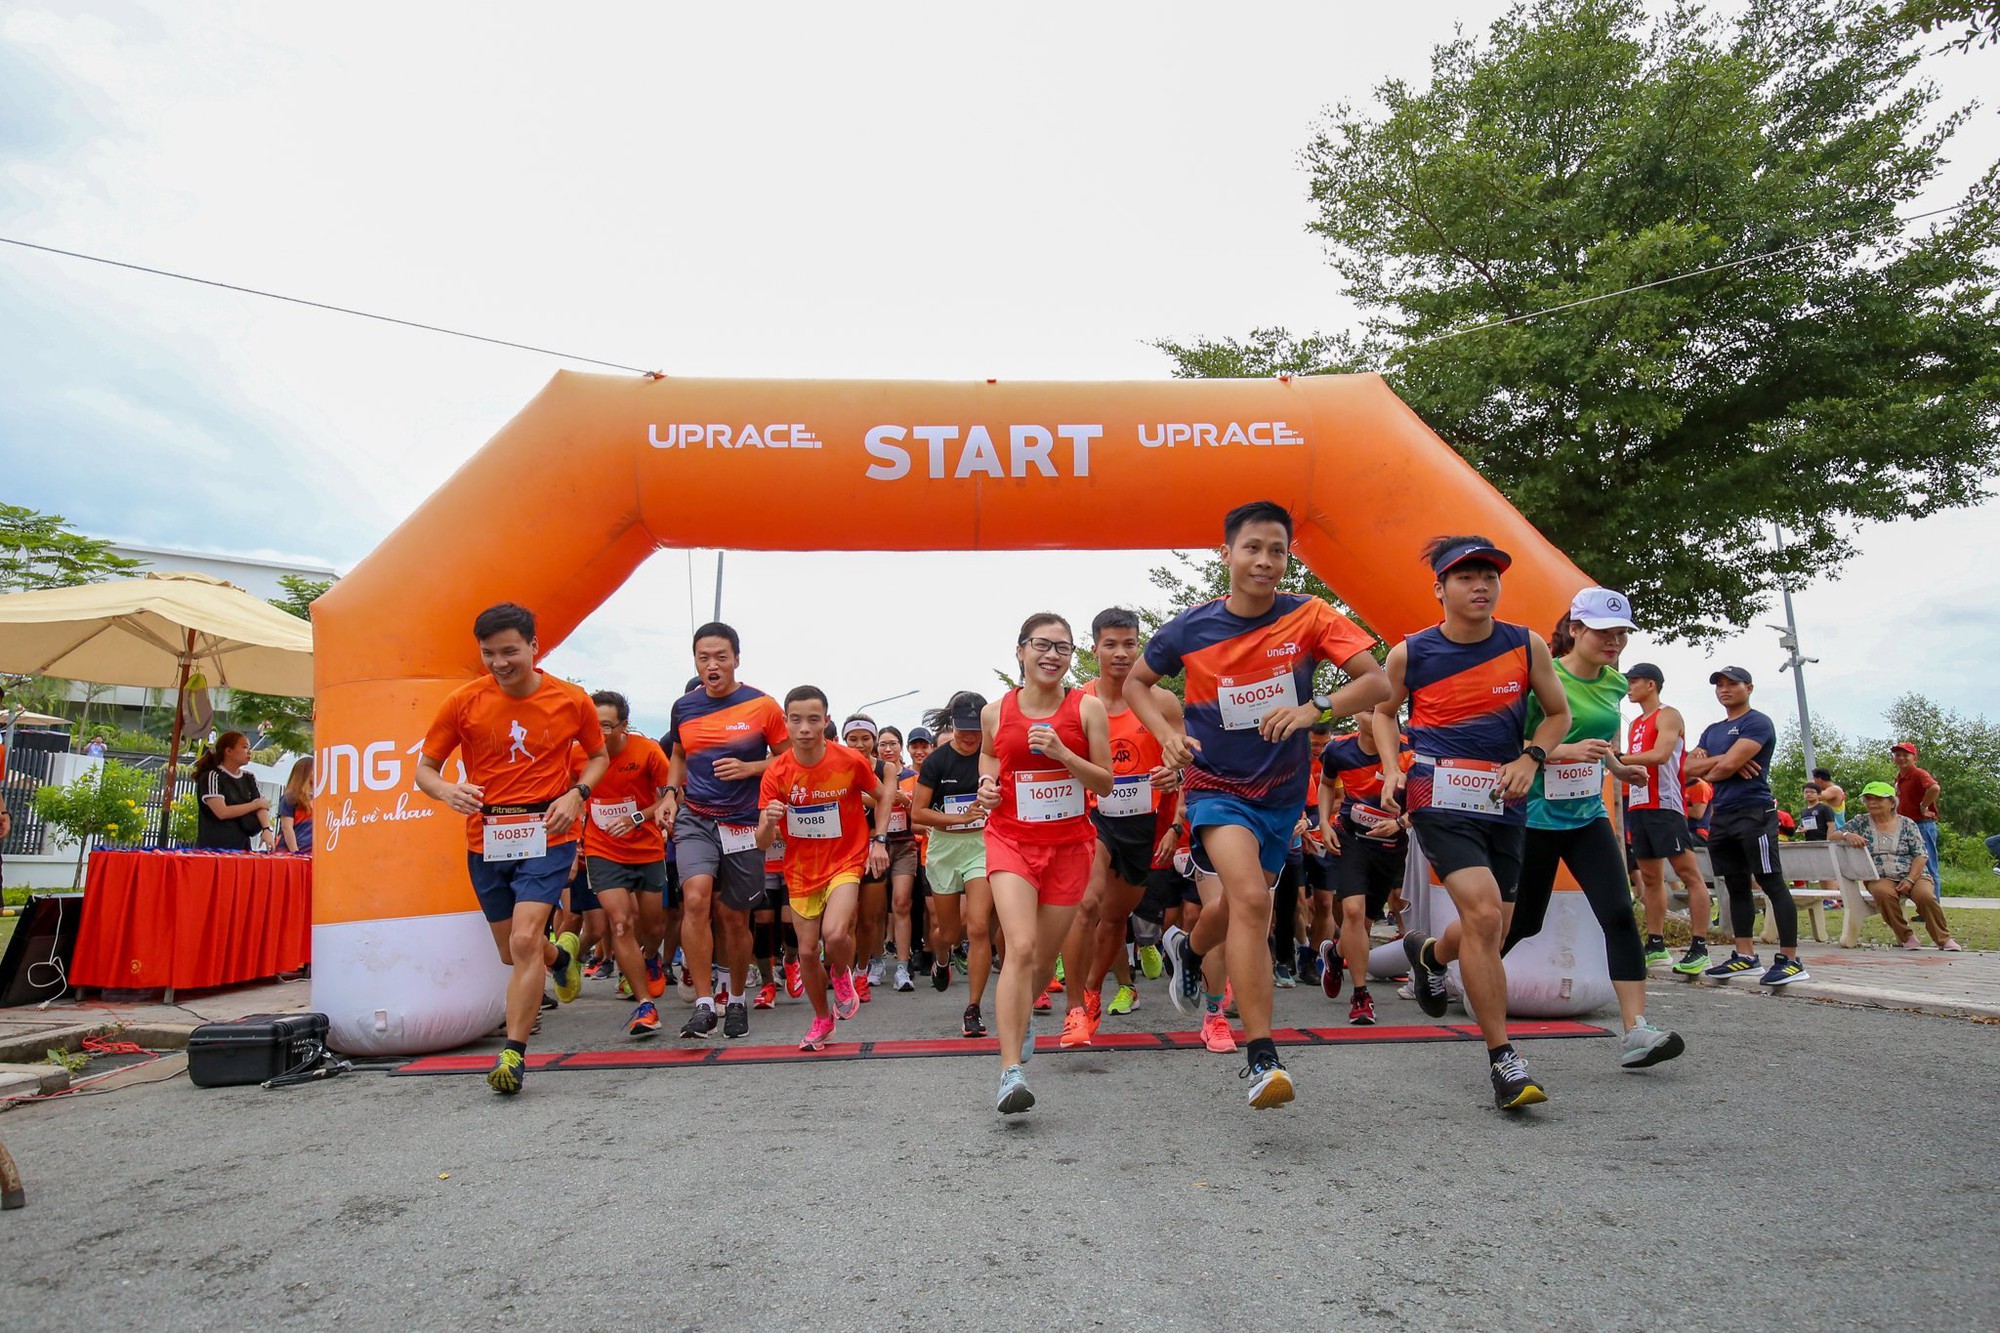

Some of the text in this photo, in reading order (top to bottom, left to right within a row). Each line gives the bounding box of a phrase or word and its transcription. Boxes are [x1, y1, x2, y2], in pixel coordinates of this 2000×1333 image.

[864, 424, 1104, 481] START
[1229, 683, 1284, 705] 160034
[1556, 766, 1593, 780] 160165
[1447, 773, 1495, 790] 160077
[812, 788, 847, 799] iRace.vn
[1029, 784, 1073, 800] 160172
[1112, 787, 1138, 799] 9039
[382, 791, 435, 821] nhau
[599, 806, 628, 816] 160110
[957, 805, 969, 815] 90
[797, 816, 825, 825] 9088
[1357, 813, 1383, 824] 1607
[493, 827, 535, 841] 160837
